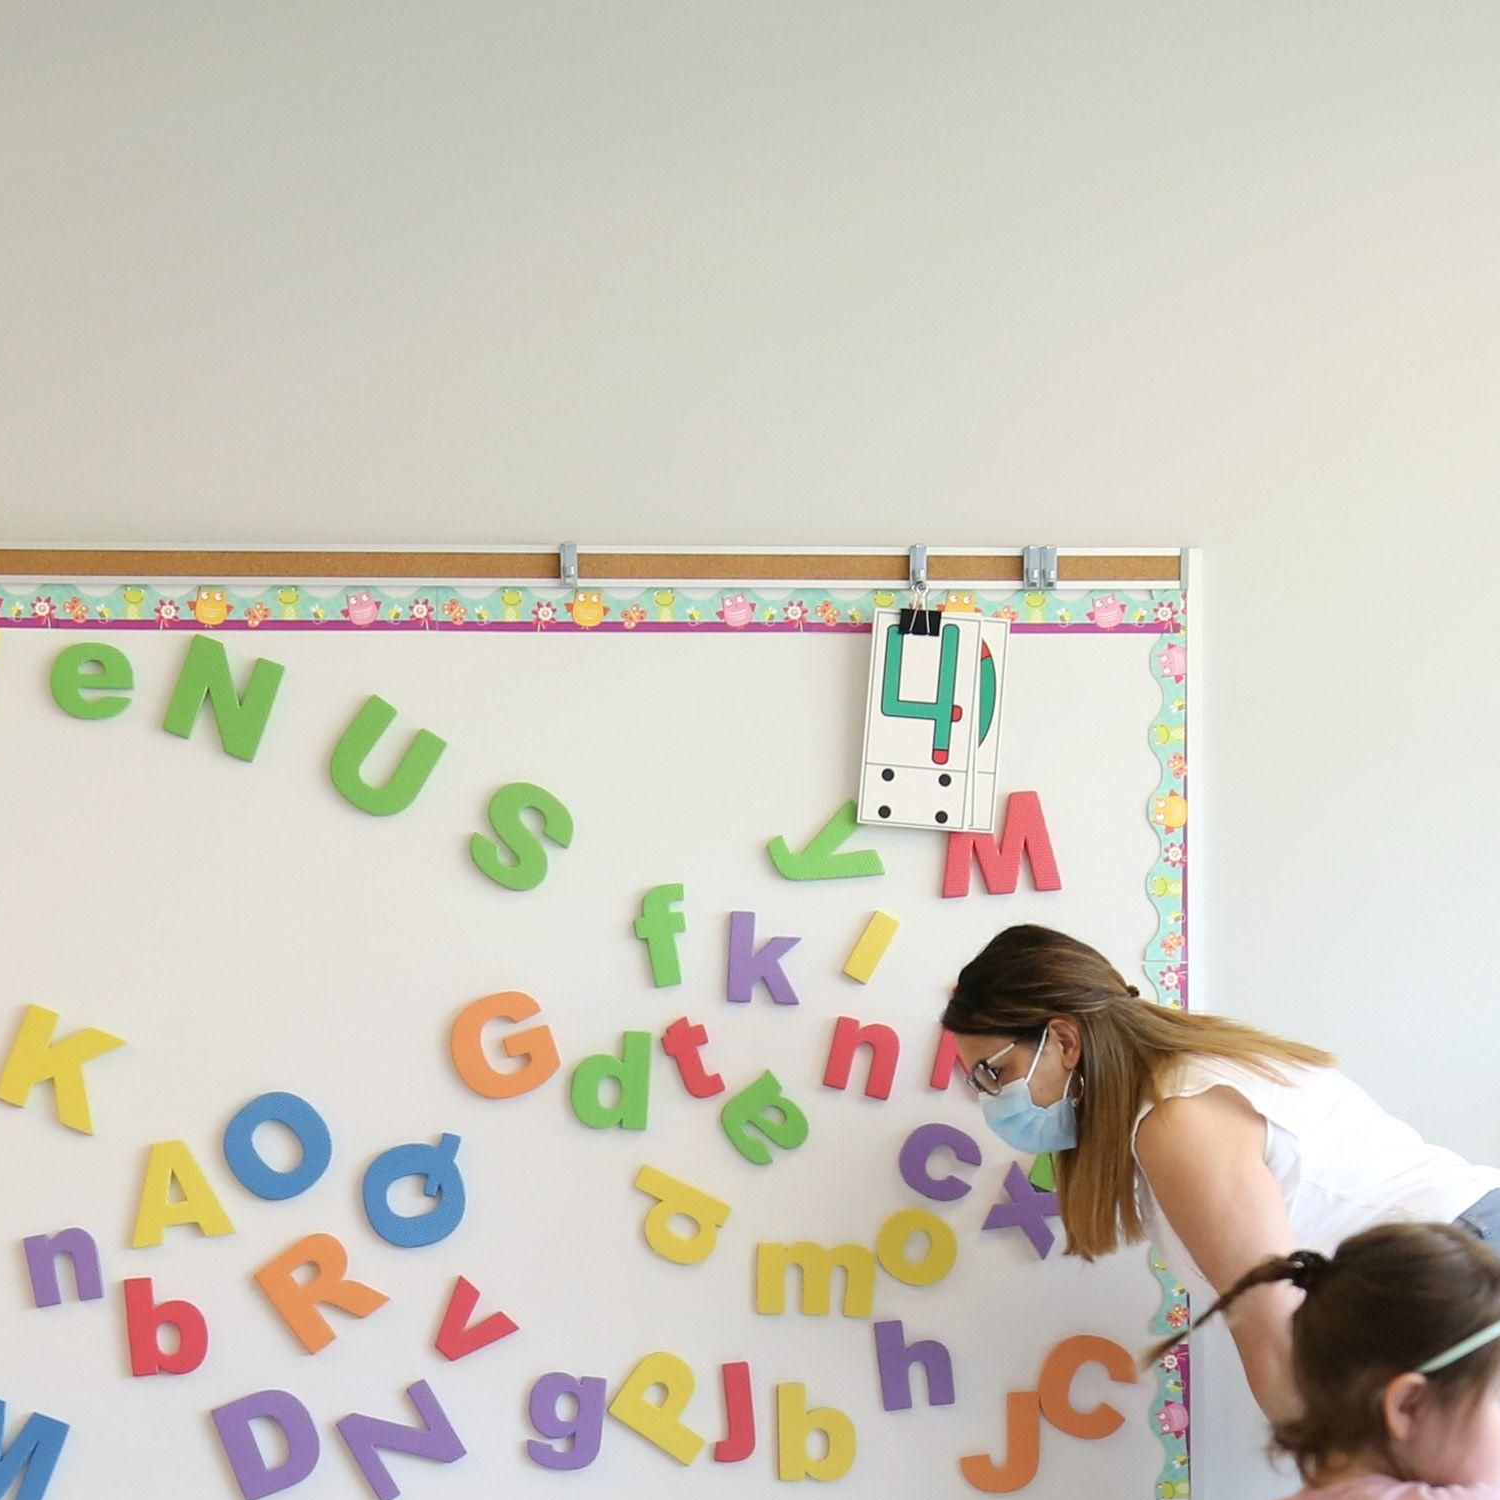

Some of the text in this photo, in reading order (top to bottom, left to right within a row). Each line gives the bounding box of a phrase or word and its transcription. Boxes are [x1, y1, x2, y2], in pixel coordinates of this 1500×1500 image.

[880, 623, 963, 766] 4
[633, 883, 686, 988] f
[449, 990, 562, 1099] G
[570, 1030, 653, 1130] d
[661, 1016, 726, 1099] t
[822, 1015, 901, 1101] n
[131, 1139, 237, 1249] A
[362, 1132, 467, 1249] Q
[23, 1227, 104, 1308] n
[253, 1232, 391, 1355] R
[122, 1276, 209, 1378] b
[873, 1320, 956, 1412] h
[526, 1370, 607, 1471] g
[775, 1381, 858, 1483] b
